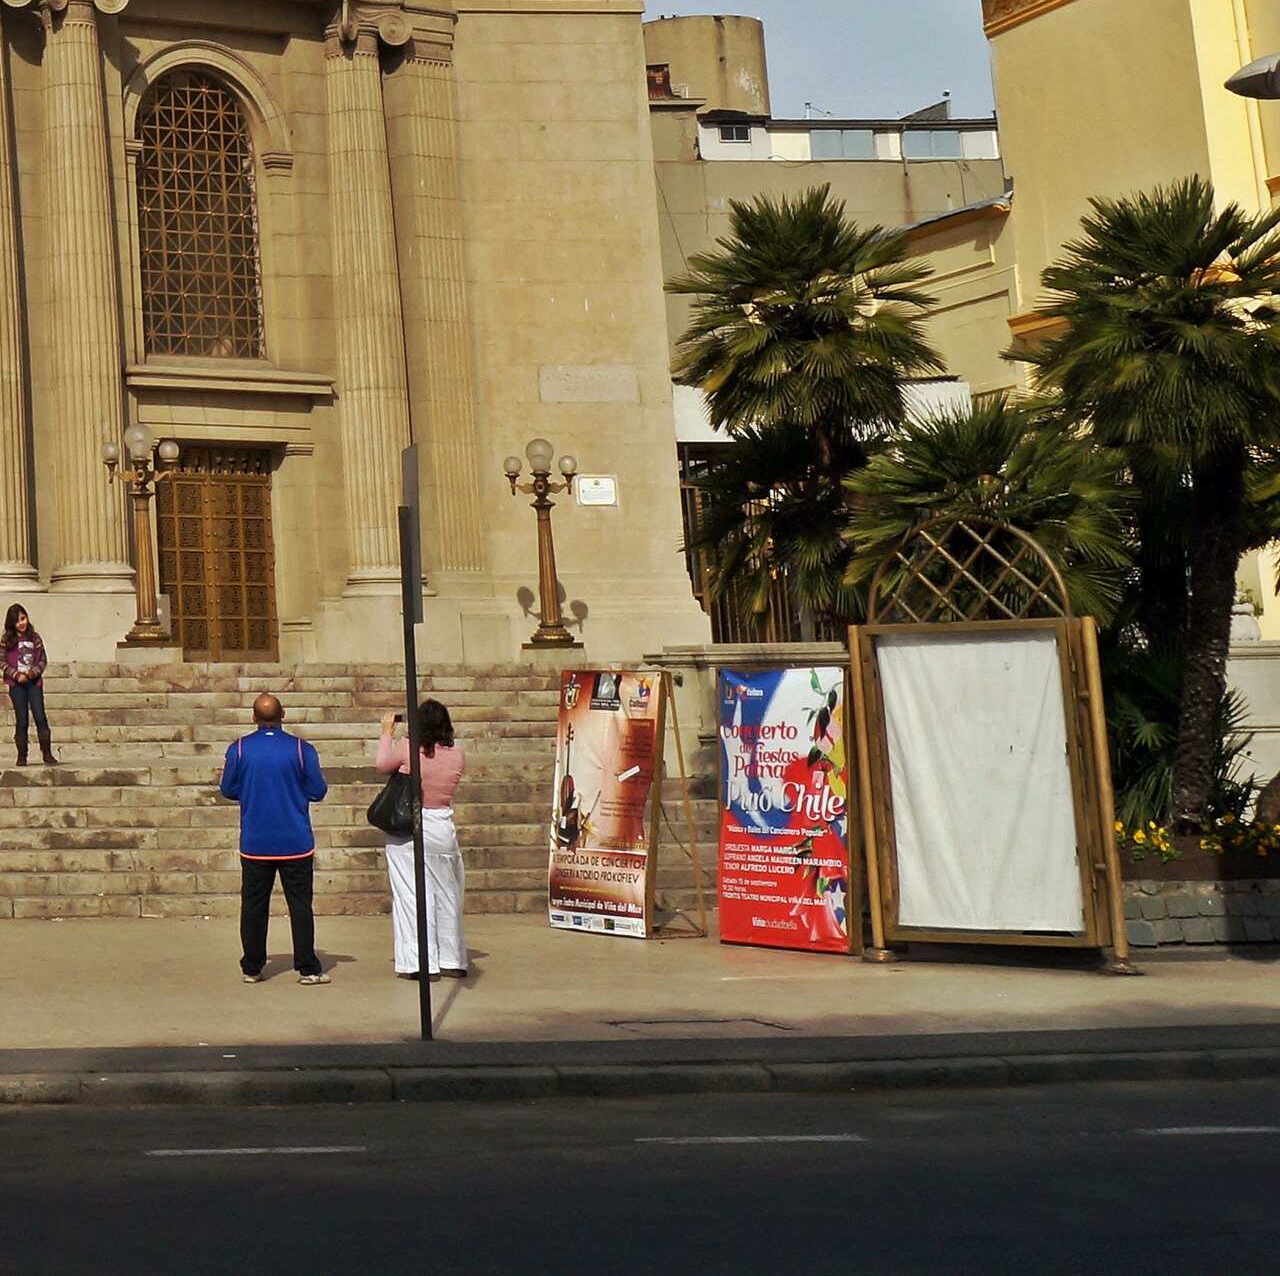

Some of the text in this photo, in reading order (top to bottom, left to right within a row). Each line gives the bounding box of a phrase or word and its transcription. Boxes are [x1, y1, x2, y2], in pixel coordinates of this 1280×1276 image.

[780, 781, 845, 822] Chile
[751, 844, 772, 853] MARGA
[773, 845, 797, 855] MARGA
[591, 856, 600, 867] DE
[747, 854, 770, 863] ANGELA
[770, 855, 802, 865] MAUREEN
[803, 857, 842, 868] MARAMBIO
[740, 863, 768, 873] ALFREDO
[768, 865, 795, 875] LUCERO
[600, 870, 640, 885] PROKOFIEV
[575, 898, 596, 911] Municipal
[597, 899, 603, 910] de
[604, 900, 616, 912] Viña
[618, 902, 626, 912] del
[627, 902, 642, 914] Mar
